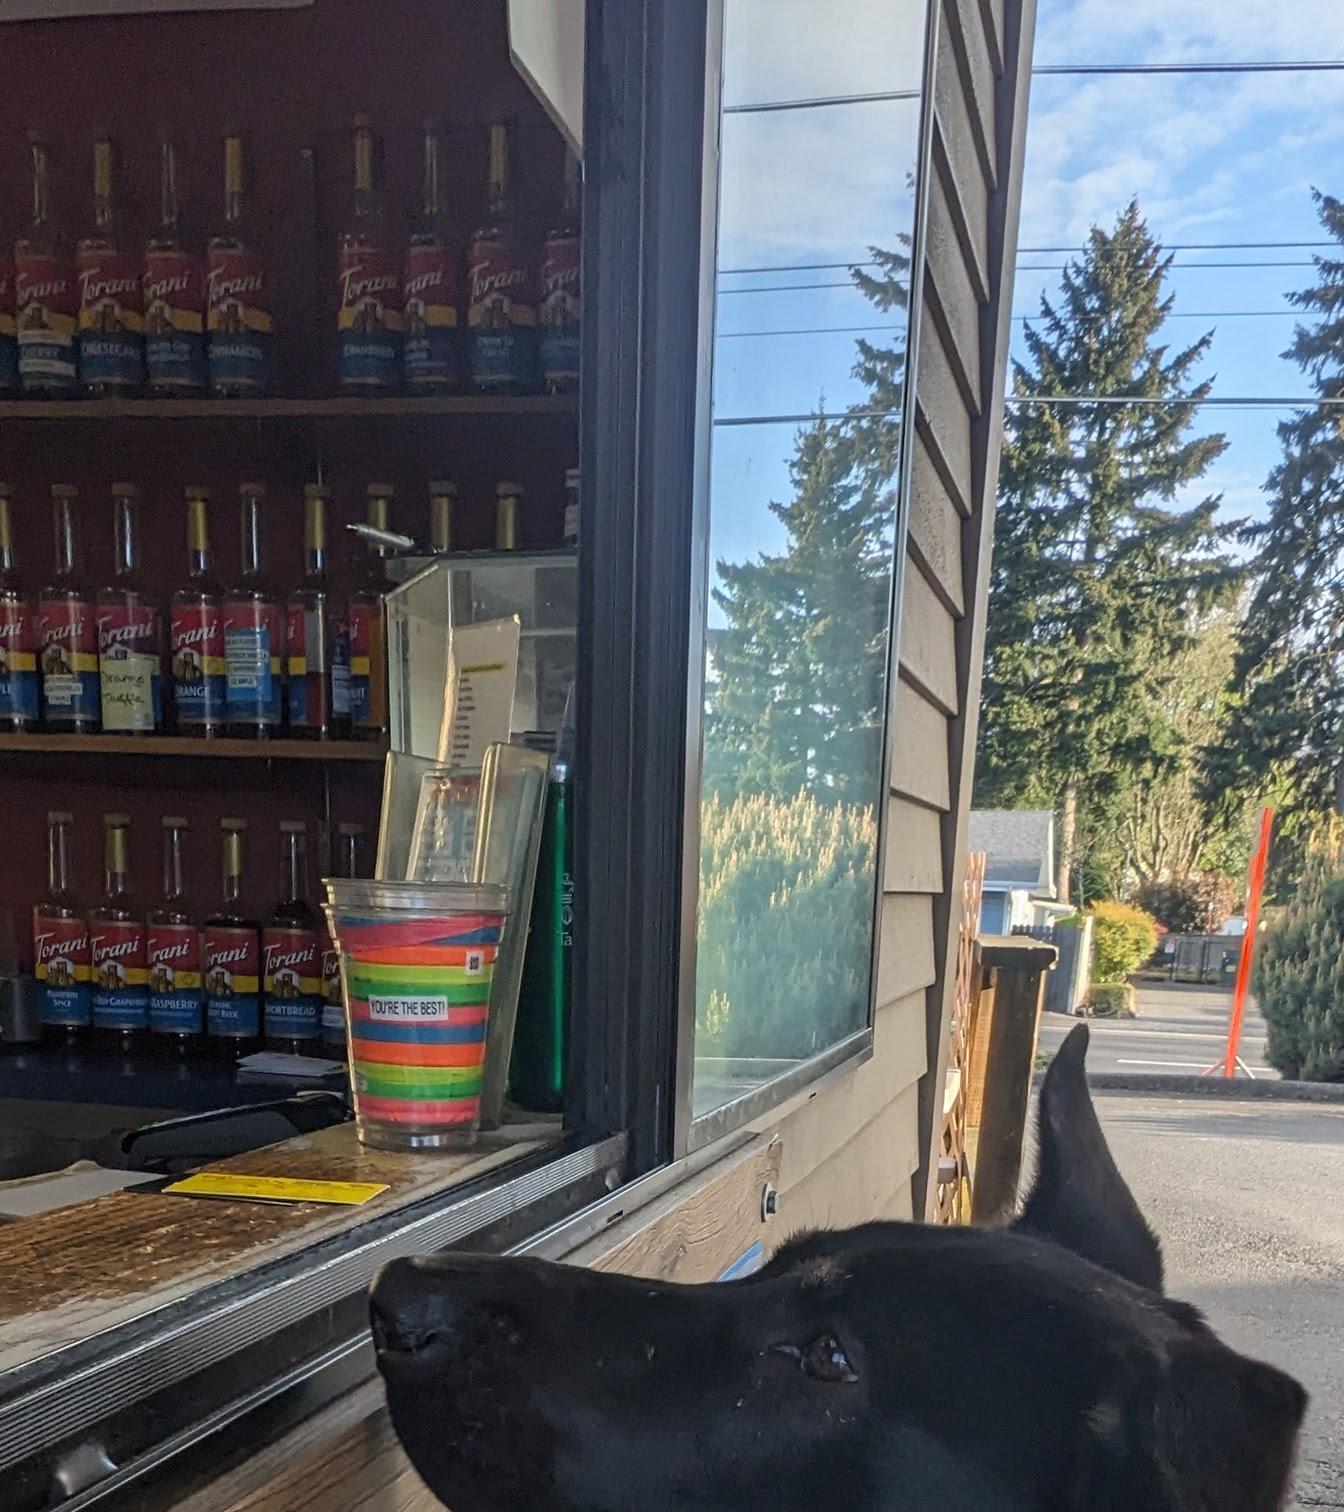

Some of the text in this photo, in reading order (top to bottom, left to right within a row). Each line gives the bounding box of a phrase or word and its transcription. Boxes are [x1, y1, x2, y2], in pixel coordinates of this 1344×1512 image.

[34, 932, 87, 965] Torani
[264, 943, 316, 975] Torani
[370, 1000, 446, 1016] YOU'RE THE BEST!
